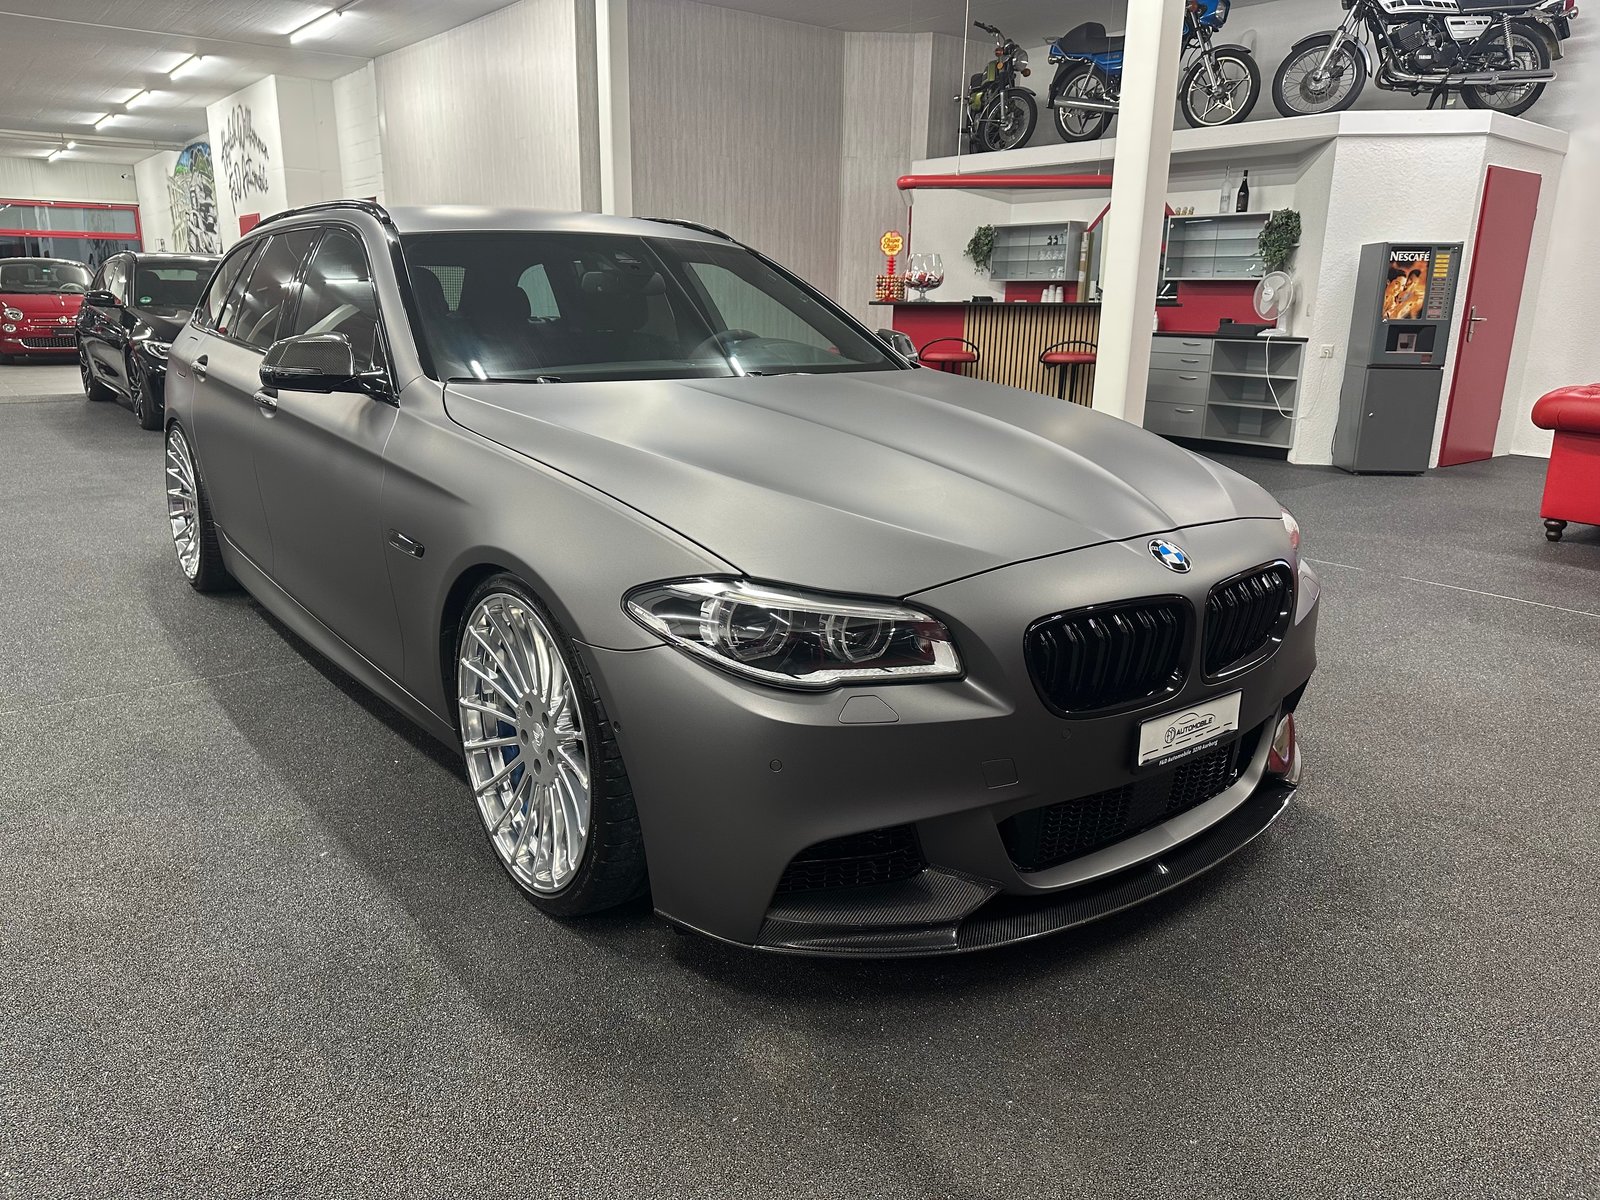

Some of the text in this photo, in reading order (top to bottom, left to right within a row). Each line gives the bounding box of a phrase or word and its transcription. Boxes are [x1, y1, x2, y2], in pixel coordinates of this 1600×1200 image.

[1389, 250, 1430, 261] NESCAFÉ
[1176, 717, 1213, 735] AUTOMOBILE
[1167, 750, 1192, 762] Automobile
